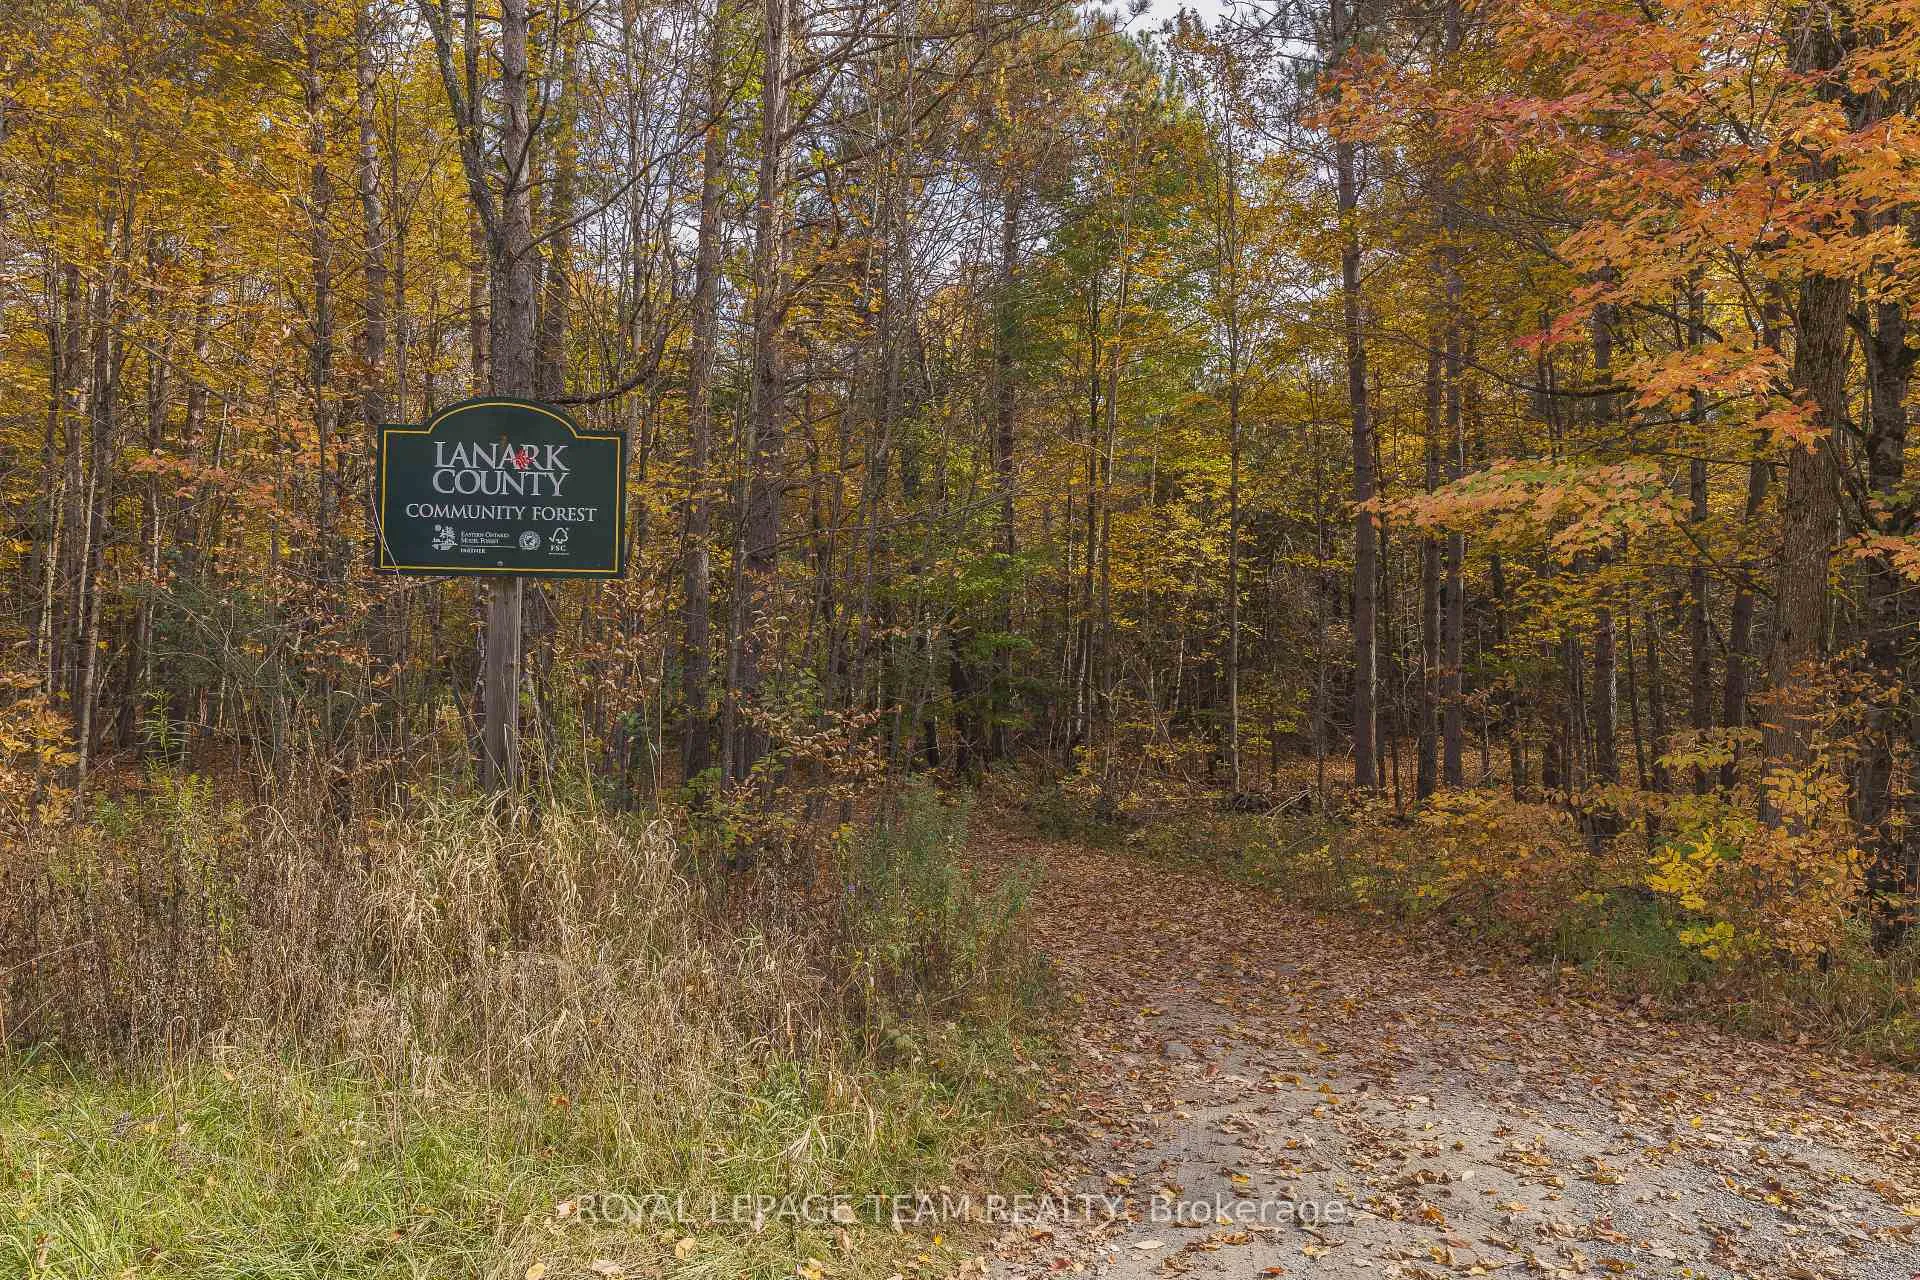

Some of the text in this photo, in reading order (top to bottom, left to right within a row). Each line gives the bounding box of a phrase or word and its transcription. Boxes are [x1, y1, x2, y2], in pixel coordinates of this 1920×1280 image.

[434, 441, 570, 471] LANARK
[432, 468, 568, 497] COUNTY
[405, 503, 598, 522] COMMUNITY FOREST
[550, 544, 567, 552] FSC
